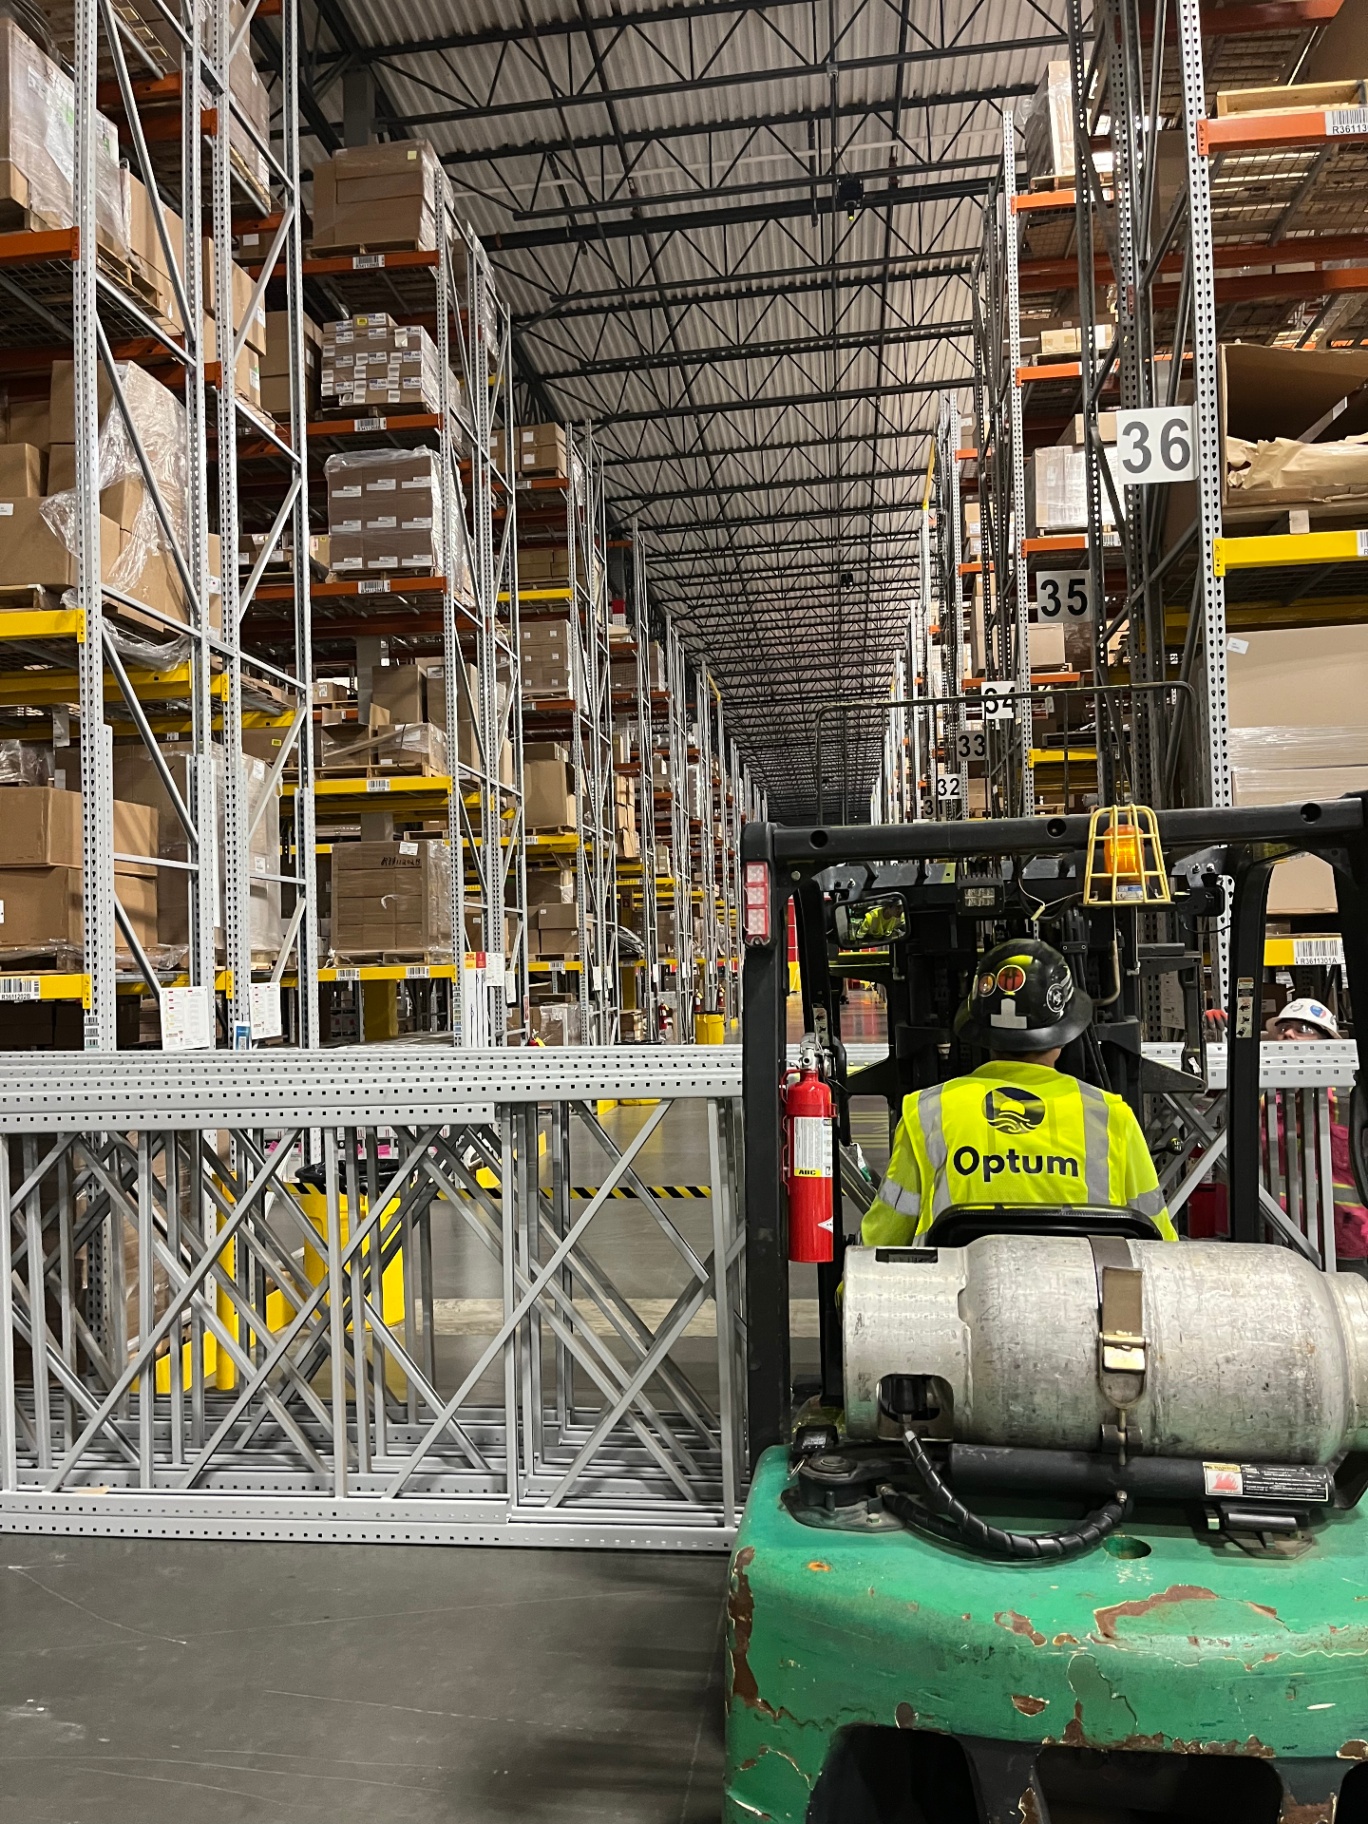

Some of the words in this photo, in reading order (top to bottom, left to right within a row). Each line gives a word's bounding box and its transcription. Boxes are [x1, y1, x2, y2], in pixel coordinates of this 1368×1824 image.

[1332, 125, 1368, 135] R36113
[1122, 418, 1191, 473] 36
[1040, 578, 1088, 617] 35
[984, 687, 1018, 714] 34
[958, 734, 985, 757] 33
[937, 778, 960, 796] 32
[925, 800, 943, 815] 31
[953, 1146, 1079, 1183] Optum
